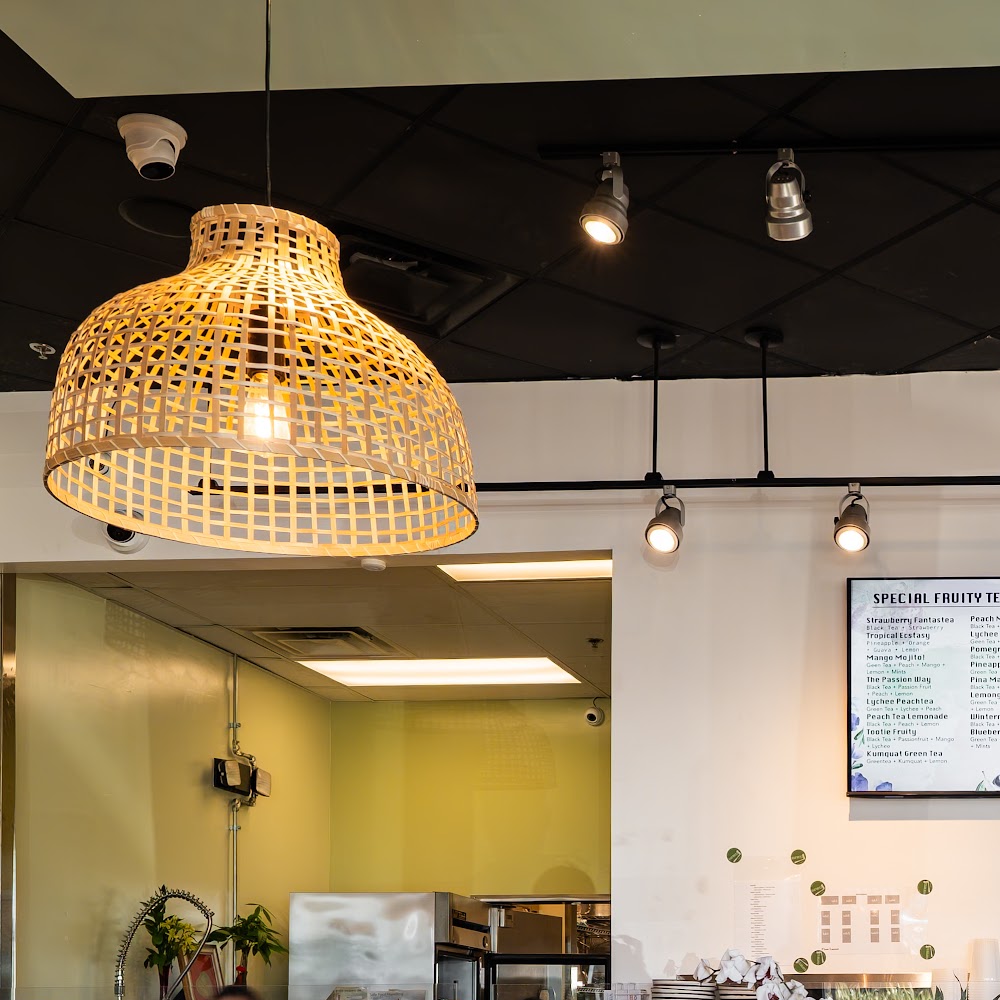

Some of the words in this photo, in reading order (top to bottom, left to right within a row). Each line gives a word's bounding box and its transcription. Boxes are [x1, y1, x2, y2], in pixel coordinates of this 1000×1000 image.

[874, 593, 929, 604] SPECIAL
[935, 593, 982, 603] FRUITY
[914, 676, 931, 684] Way
